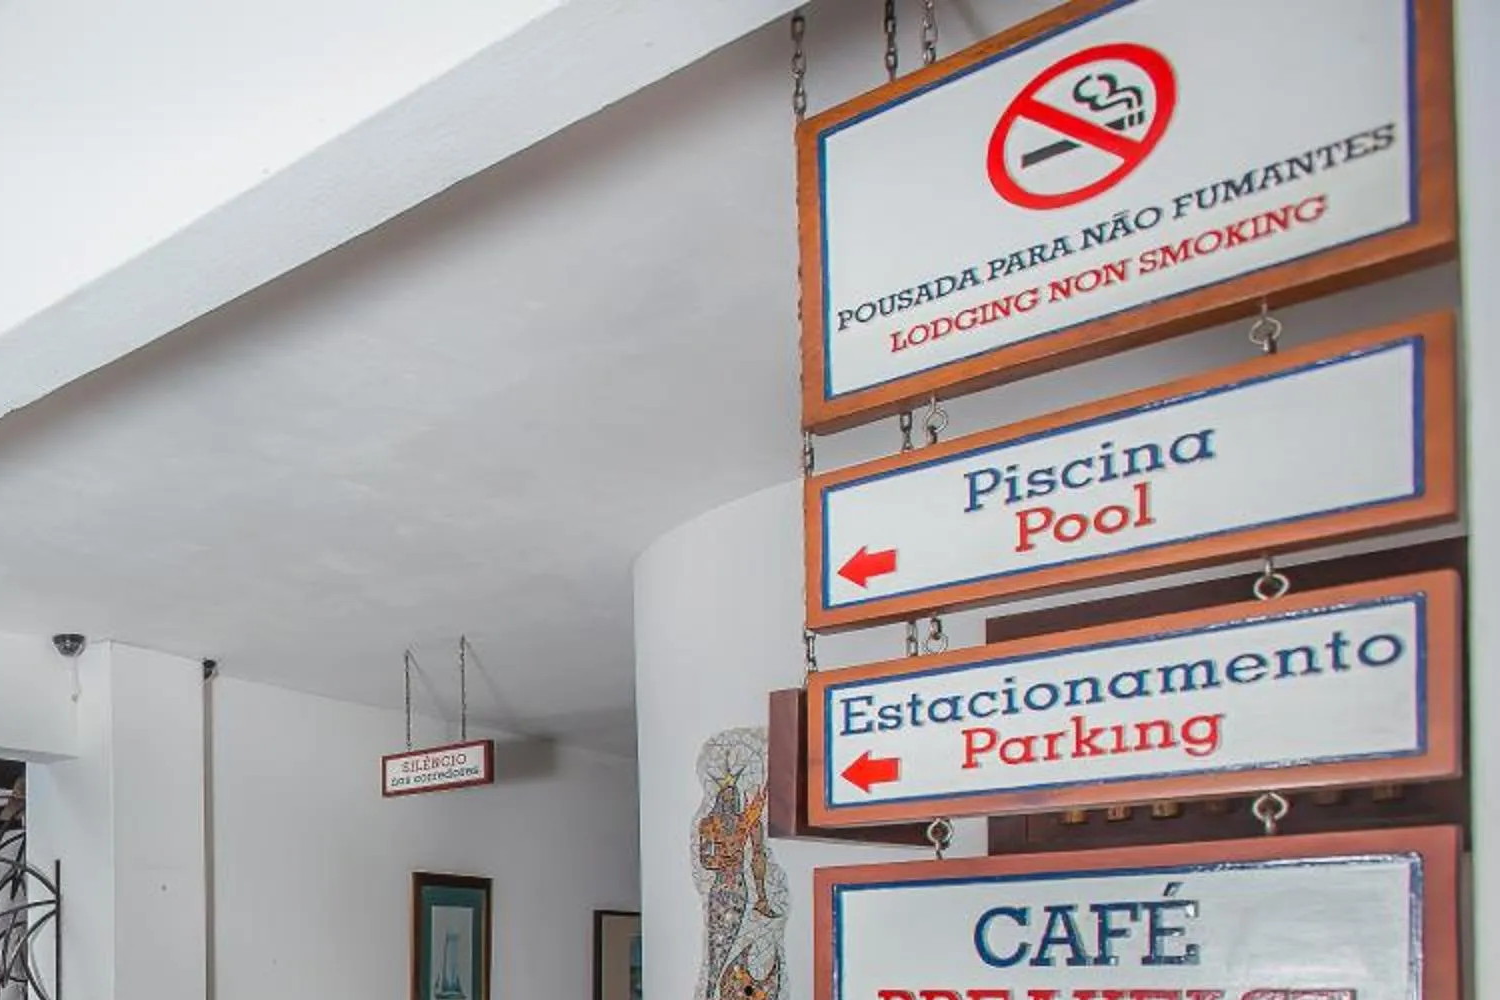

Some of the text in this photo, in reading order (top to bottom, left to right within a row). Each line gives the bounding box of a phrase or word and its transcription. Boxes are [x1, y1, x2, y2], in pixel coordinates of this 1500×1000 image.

[837, 122, 1398, 331] POUSADA PARA NÃO FUMANTES
[889, 193, 1329, 354] LODGING NON SMOKING
[963, 427, 1217, 514] Piscina
[1014, 482, 1155, 553] Pool
[839, 628, 1407, 737] Estacionamento
[961, 712, 1226, 770] Parking
[973, 882, 1200, 968] CAFÉ
